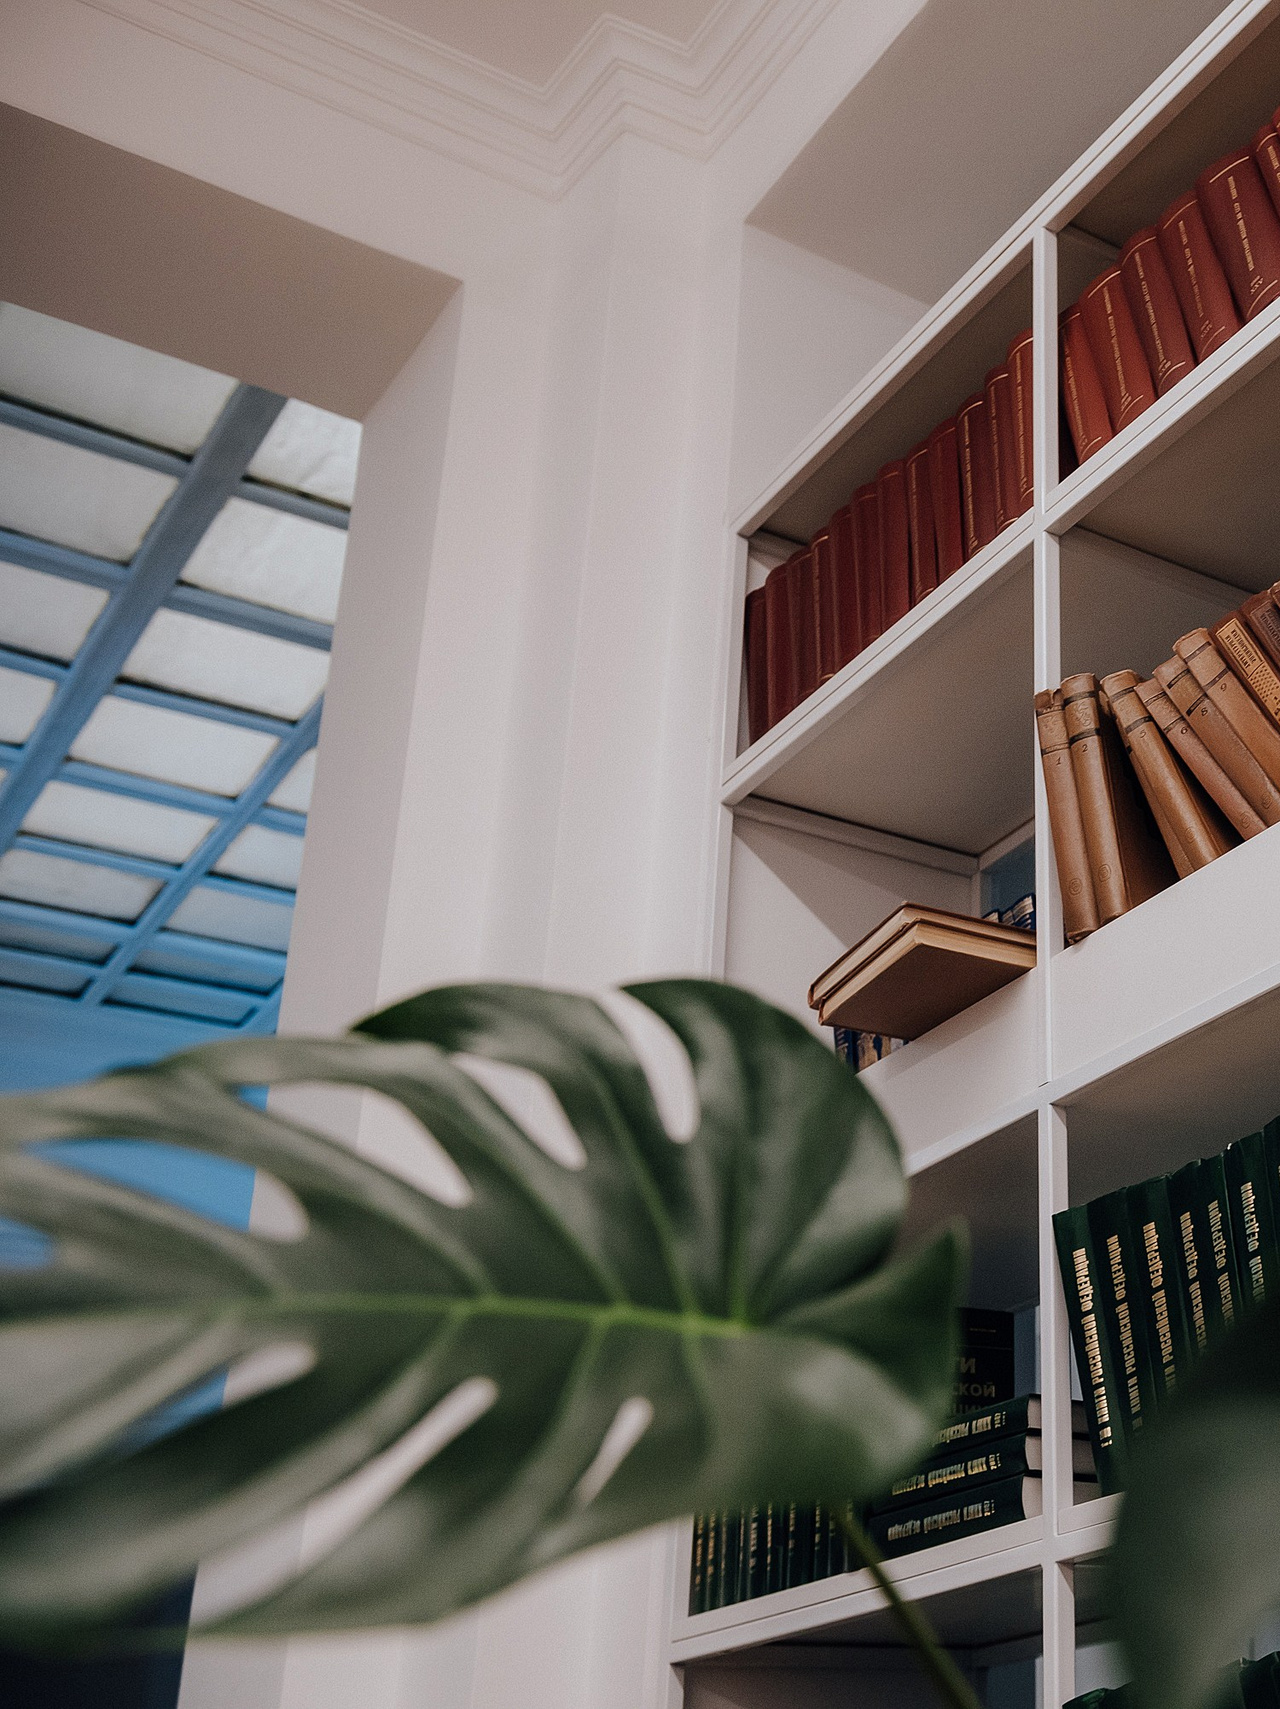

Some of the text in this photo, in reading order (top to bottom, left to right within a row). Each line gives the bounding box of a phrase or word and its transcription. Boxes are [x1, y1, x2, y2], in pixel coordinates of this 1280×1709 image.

[1201, 707, 1208, 716] 8
[1056, 757, 1062, 766] 1
[1082, 744, 1088, 752] 2
[1180, 1212, 1198, 1279] ФЕДЕРАЦИИ
[1208, 1200, 1226, 1269] ФЕДЕРАЦИИ
[1241, 1182, 1259, 1252] ФЕДЕРАЦИИ
[1073, 1248, 1093, 1311] ФЕДЕРАЦИИ
[1143, 1222, 1163, 1288] ФЕДЕРАЦИИ
[1082, 1314, 1104, 1384] РОССИЙСКОЙ
[1107, 1235, 1140, 1414] КНИГИ РОССИЙСКОЙ ФЕДЕРАЦИИ
[1152, 1289, 1173, 1363] РОССИЙСКОЙ
[1094, 1386, 1109, 1424] КНИГИ
